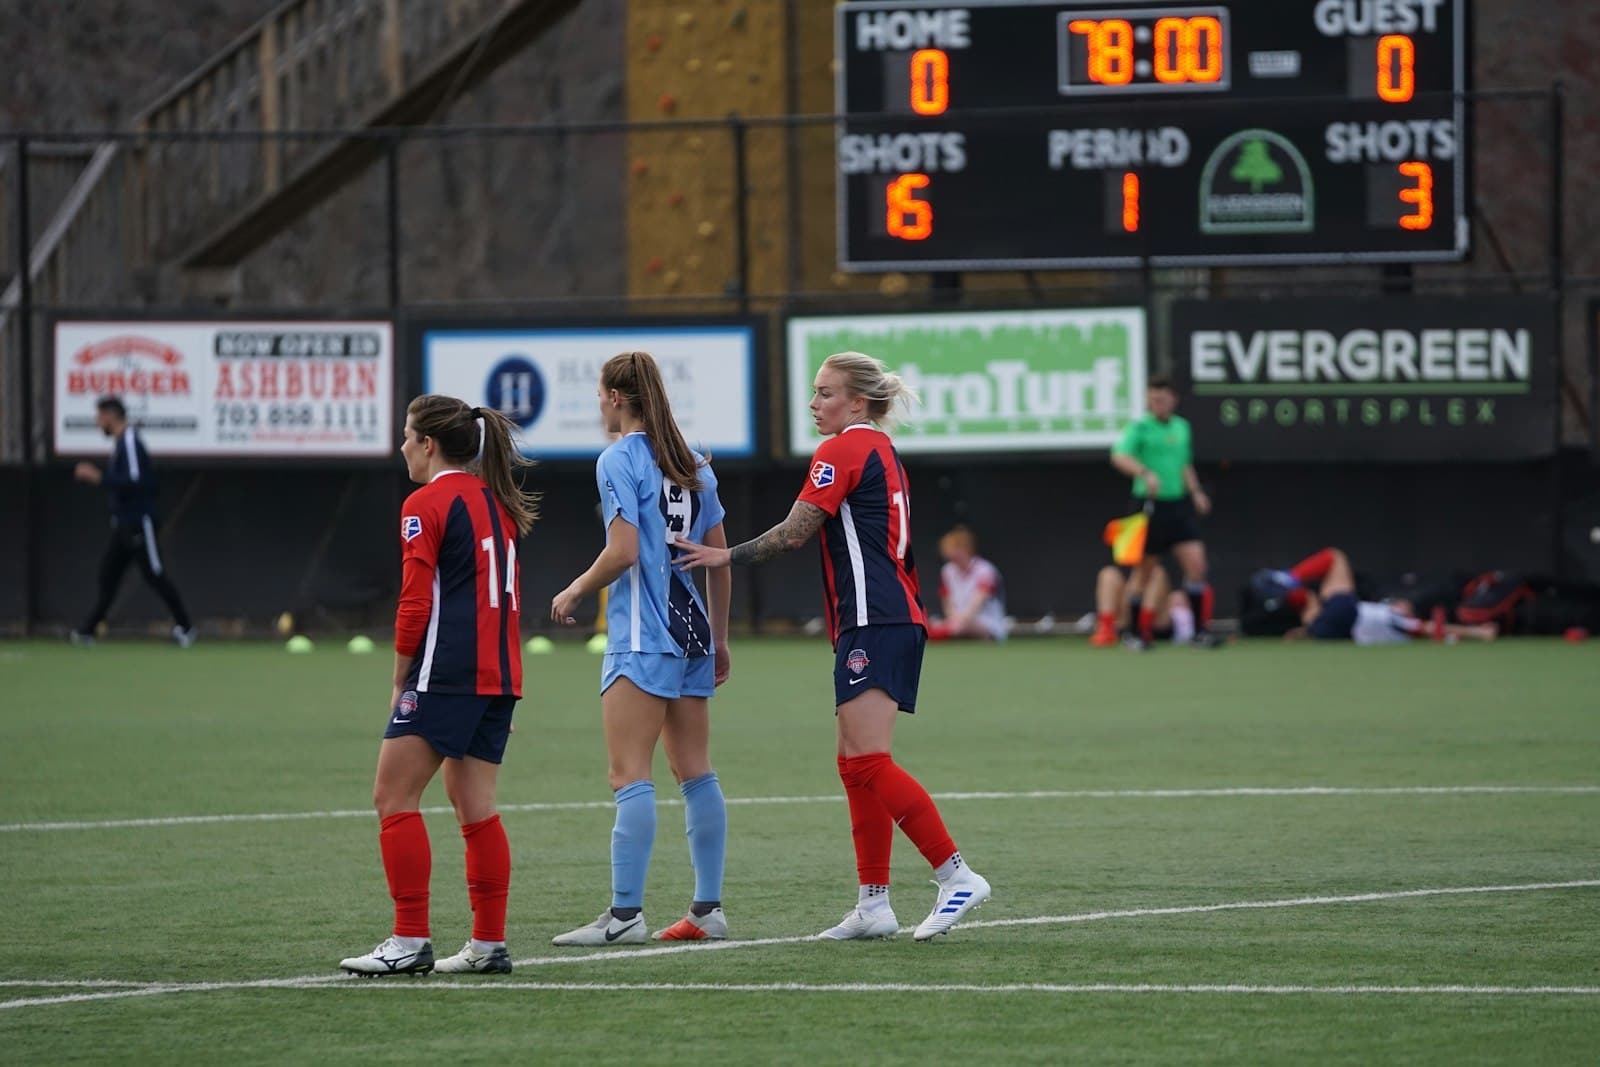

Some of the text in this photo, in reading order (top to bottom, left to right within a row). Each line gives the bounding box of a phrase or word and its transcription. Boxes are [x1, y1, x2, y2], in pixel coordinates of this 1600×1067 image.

[857, 11, 970, 50] HOME
[1314, 0, 1443, 34] GUEST
[1068, 16, 1223, 86] 78:00
[1377, 35, 1414, 102] 0
[911, 49, 948, 115] 0
[841, 132, 966, 174] SHOTS
[1325, 120, 1456, 162] SHOTS
[886, 173, 932, 241] 6
[1122, 172, 1139, 232] 1
[1399, 162, 1433, 230] 3
[216, 362, 377, 399] ASHBURN
[1190, 329, 1530, 382] EVERGREEN
[68, 370, 190, 395] BURGER
[1219, 399, 1496, 426] SPORTSPLEX
[481, 535, 518, 611] 14
